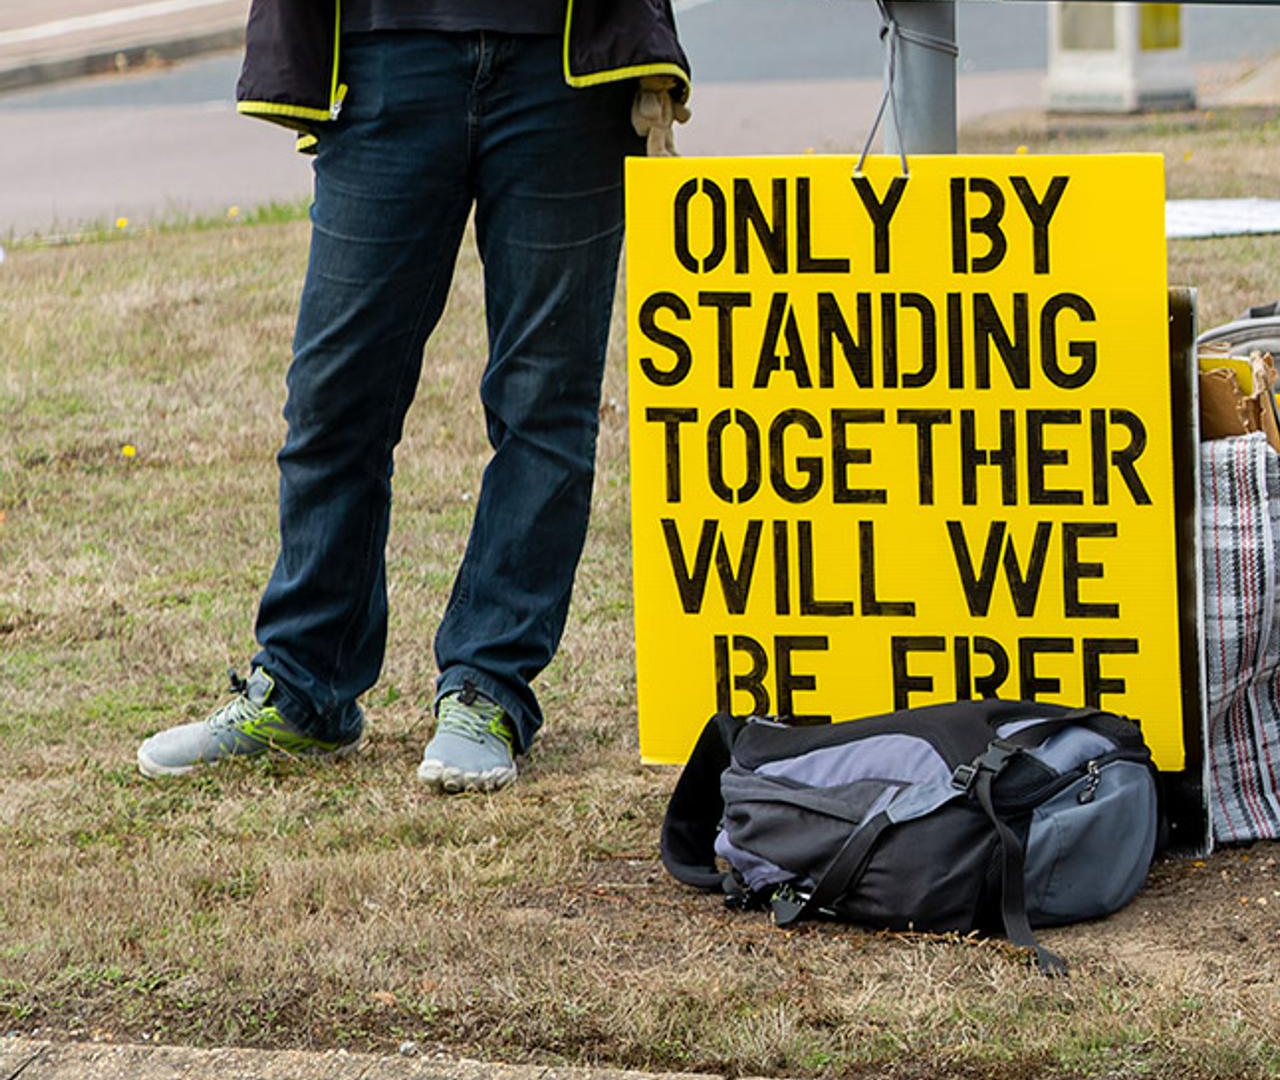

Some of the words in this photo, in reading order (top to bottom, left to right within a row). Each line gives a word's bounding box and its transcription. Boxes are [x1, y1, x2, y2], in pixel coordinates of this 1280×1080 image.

[673, 176, 909, 275] ONLY
[949, 175, 1071, 275] BY
[638, 290, 1098, 390] STANDING
[645, 407, 1153, 507] TOGETHER
[660, 518, 916, 618] WILL
[945, 520, 1120, 619] WE
[713, 635, 833, 724] BE
[890, 635, 1141, 722] FREE
